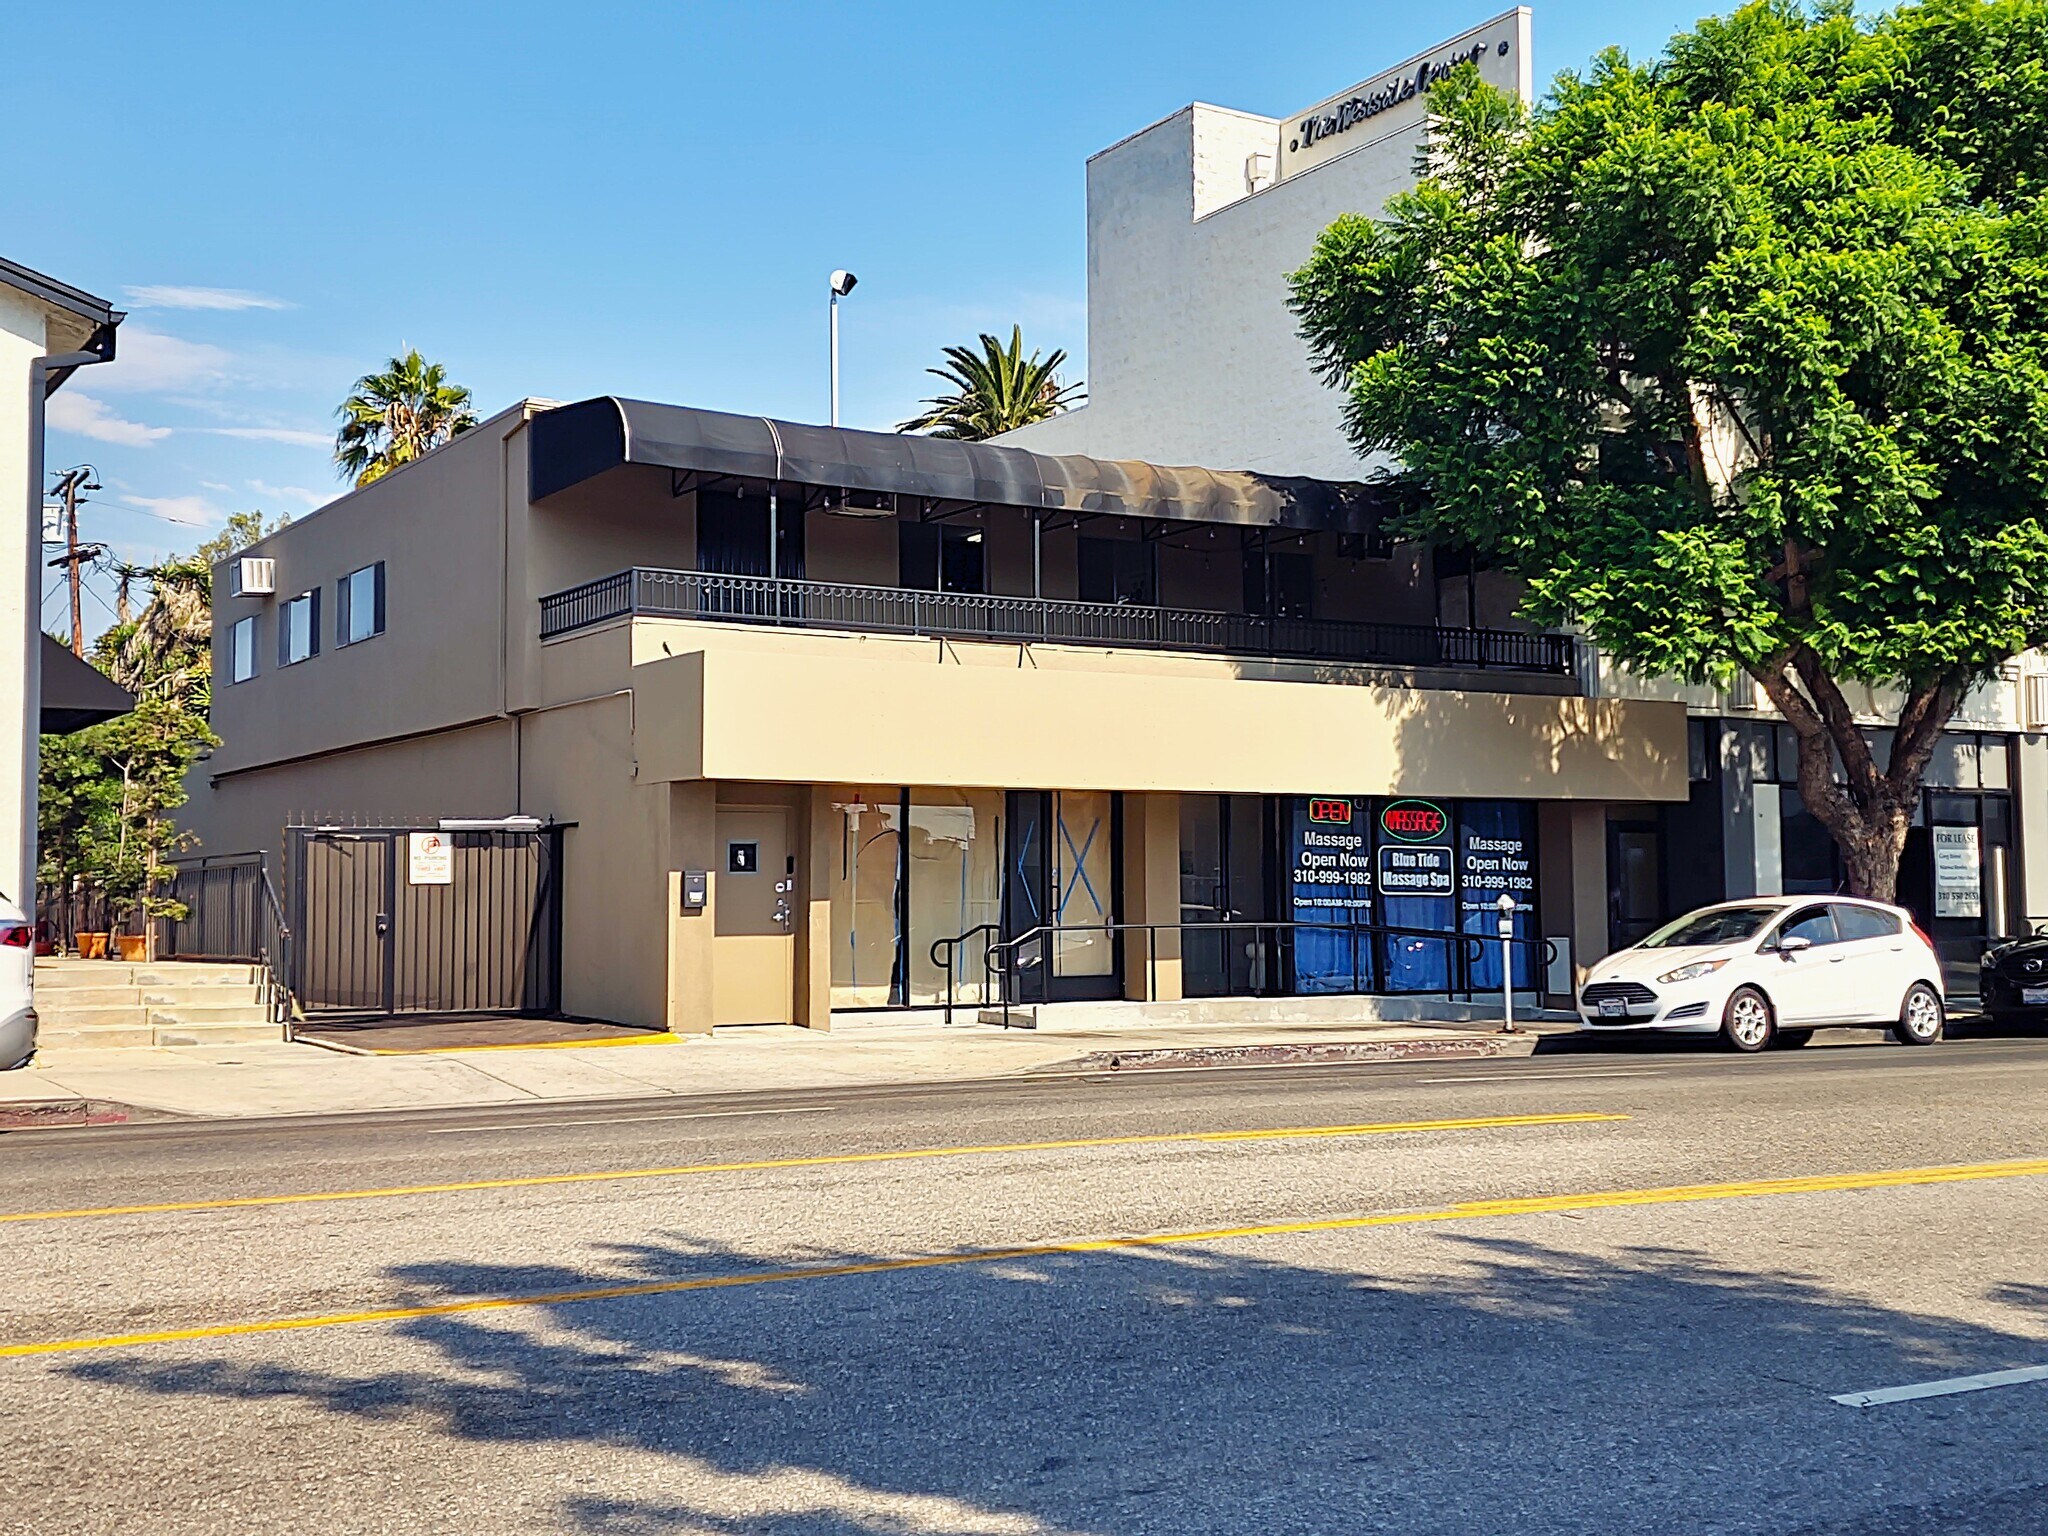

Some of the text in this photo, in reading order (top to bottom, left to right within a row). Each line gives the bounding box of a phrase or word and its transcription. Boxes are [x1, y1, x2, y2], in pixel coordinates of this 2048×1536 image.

[1300, 115, 1337, 149] The
[1337, 77, 1414, 133] Westside
[1311, 801, 1349, 821] OPEN
[1385, 811, 1441, 832] MASSAGE
[1304, 831, 1362, 850] Massage
[1469, 836, 1523, 854] Massage
[1936, 833, 1975, 844] FOR LEASE
[1301, 851, 1369, 870] Open Now
[1392, 852, 1440, 868] Blue Tide
[1466, 855, 1529, 873] Open Now
[1293, 869, 1371, 885] 310-999-1982
[1383, 871, 1450, 887] Massage Spa
[1461, 874, 1533, 889] 310-999-1982
[1293, 897, 1313, 908] Open
[1462, 902, 1479, 911] Open
